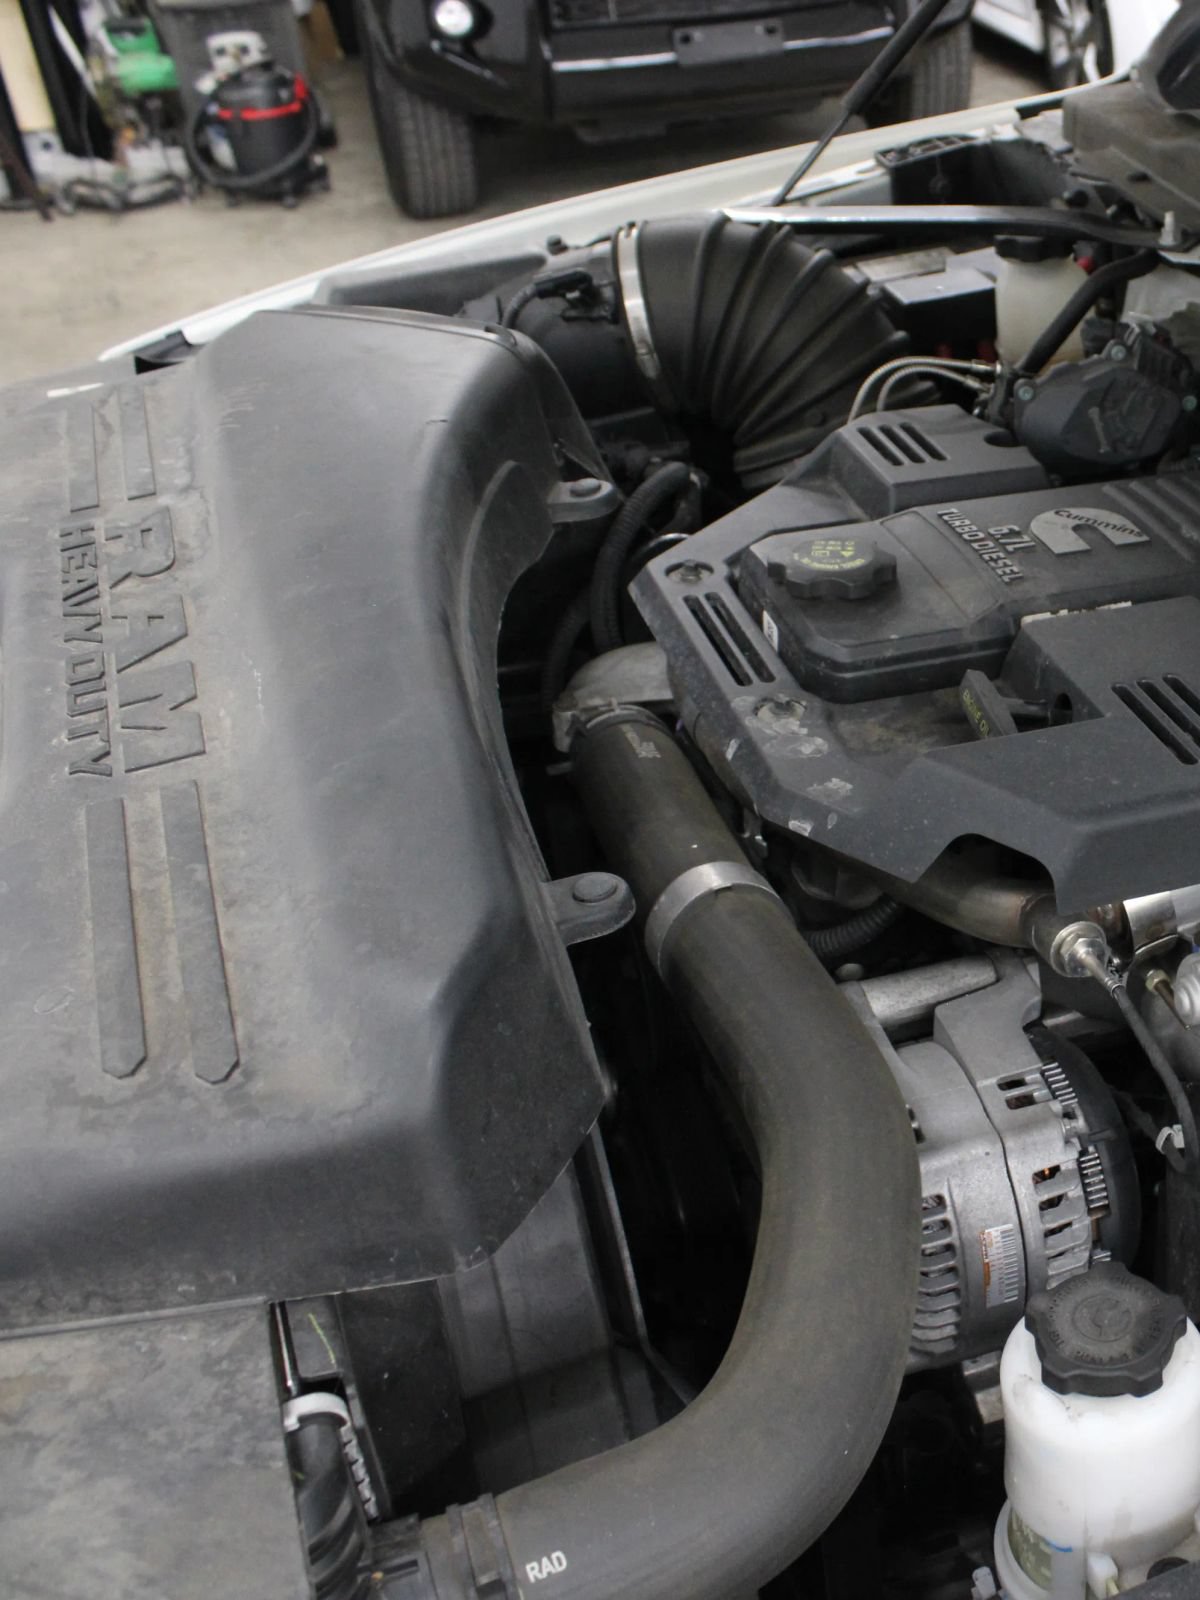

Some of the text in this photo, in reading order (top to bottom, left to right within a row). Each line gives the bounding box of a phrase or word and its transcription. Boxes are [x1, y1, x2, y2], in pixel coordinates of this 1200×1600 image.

[936, 508, 1024, 584] TURBO DIESEL
[1053, 509, 1145, 538] Cummins
[60, 526, 113, 777] HEAVY DUTY
[104, 506, 206, 773] RAM
[525, 1550, 567, 1583] RAD
